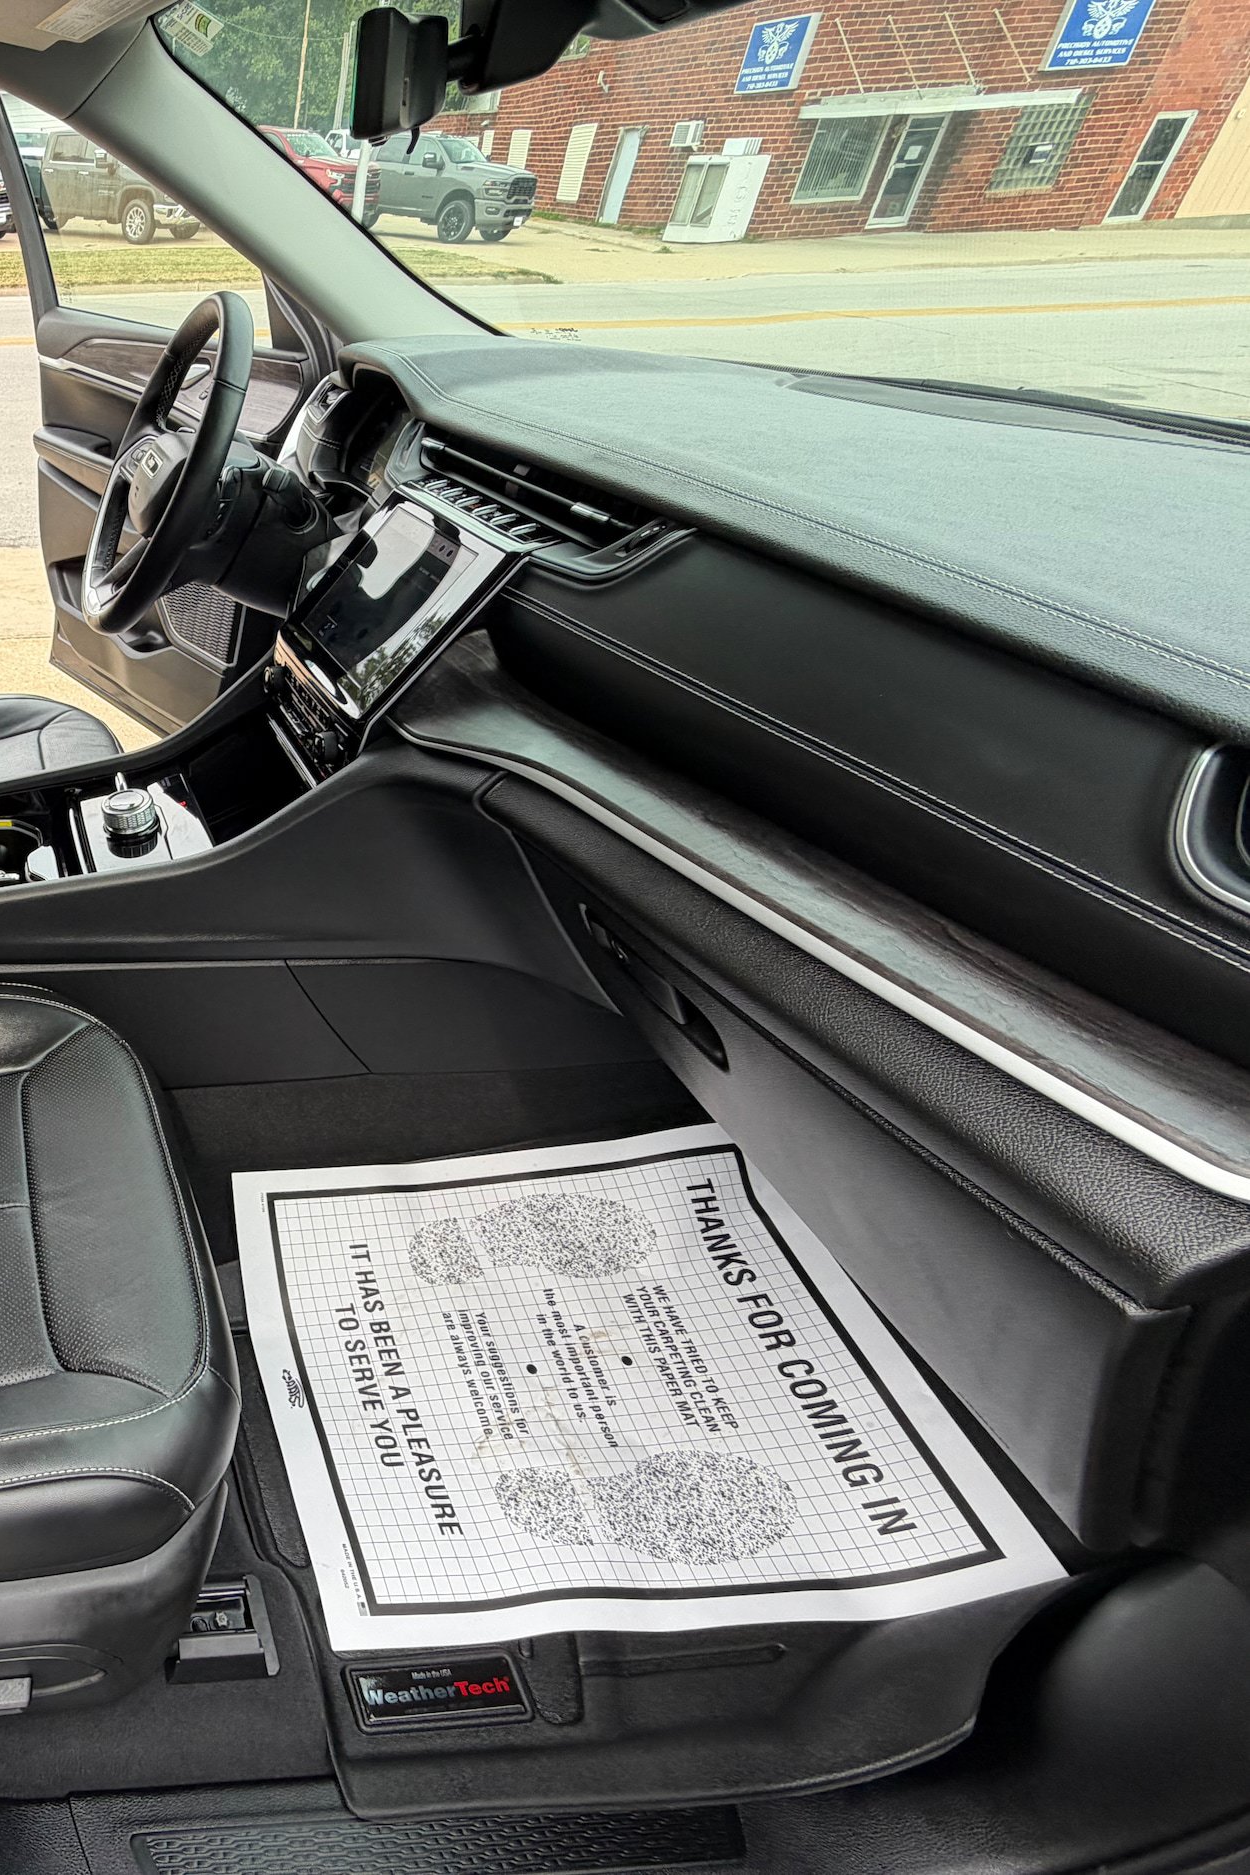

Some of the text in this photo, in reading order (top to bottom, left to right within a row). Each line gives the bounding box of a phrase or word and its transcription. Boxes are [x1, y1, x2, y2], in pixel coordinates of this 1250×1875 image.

[335, 1303, 405, 1468] TO SERVE YOU
[348, 1243, 464, 1537] IT HAS BEEN A PLEASURE
[442, 1312, 456, 1331] are
[450, 1334, 472, 1376] always
[457, 1309, 514, 1441] improving our service
[475, 1312, 529, 1435] Your suggestions for
[536, 1314, 587, 1423] in the world to us.
[542, 1288, 620, 1448] the most important person
[573, 1324, 617, 1407] A customer is
[623, 1293, 700, 1427] WITH THIS PAPER MAT
[635, 1286, 721, 1432] YOUR CARPETING CLEAN
[652, 1285, 739, 1430] WE HAVE TRIED TO KEEP
[687, 1178, 918, 1536] THANKS FOR COMING IN
